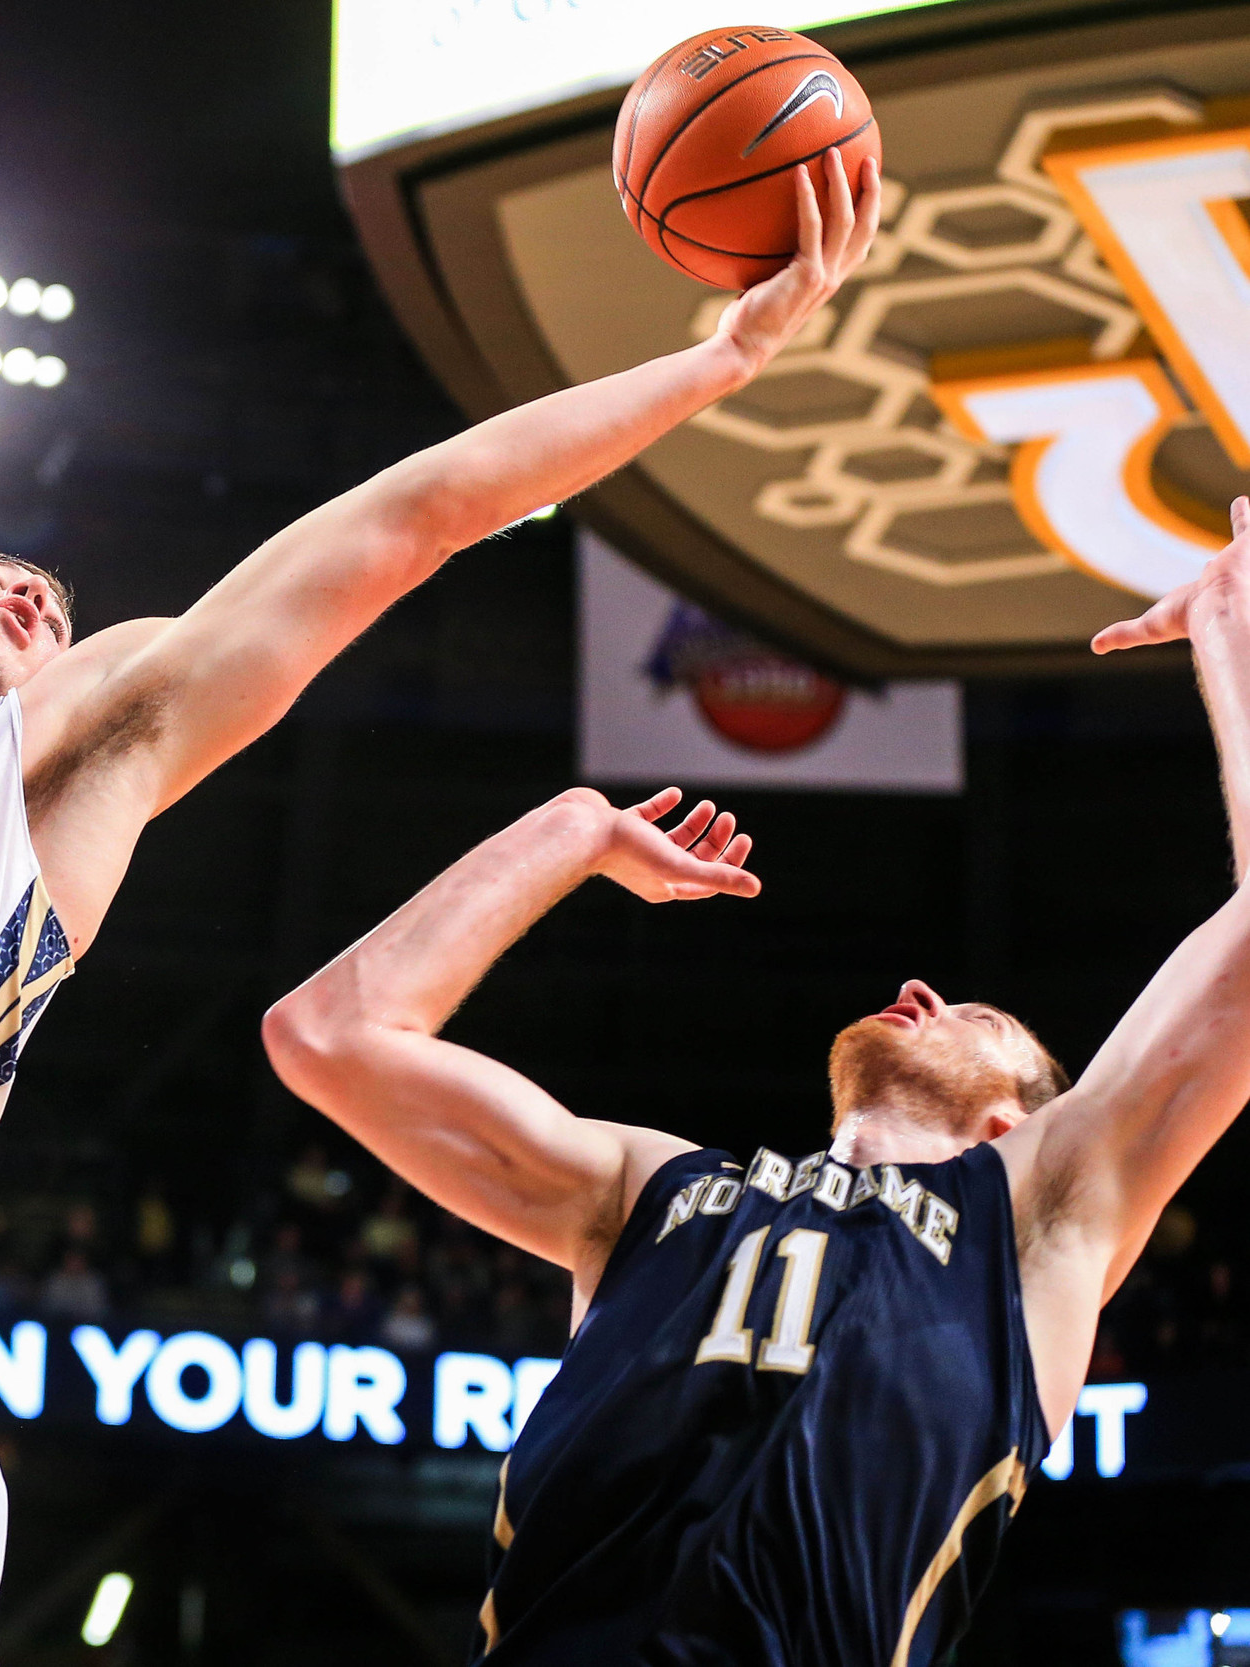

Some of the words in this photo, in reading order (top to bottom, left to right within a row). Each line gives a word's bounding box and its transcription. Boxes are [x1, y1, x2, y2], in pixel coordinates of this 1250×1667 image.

[679, 28, 793, 82] ELITE
[812, 1161, 960, 1268] DAME
[693, 1224, 830, 1376] 11
[70, 1323, 408, 1445] YOUR
